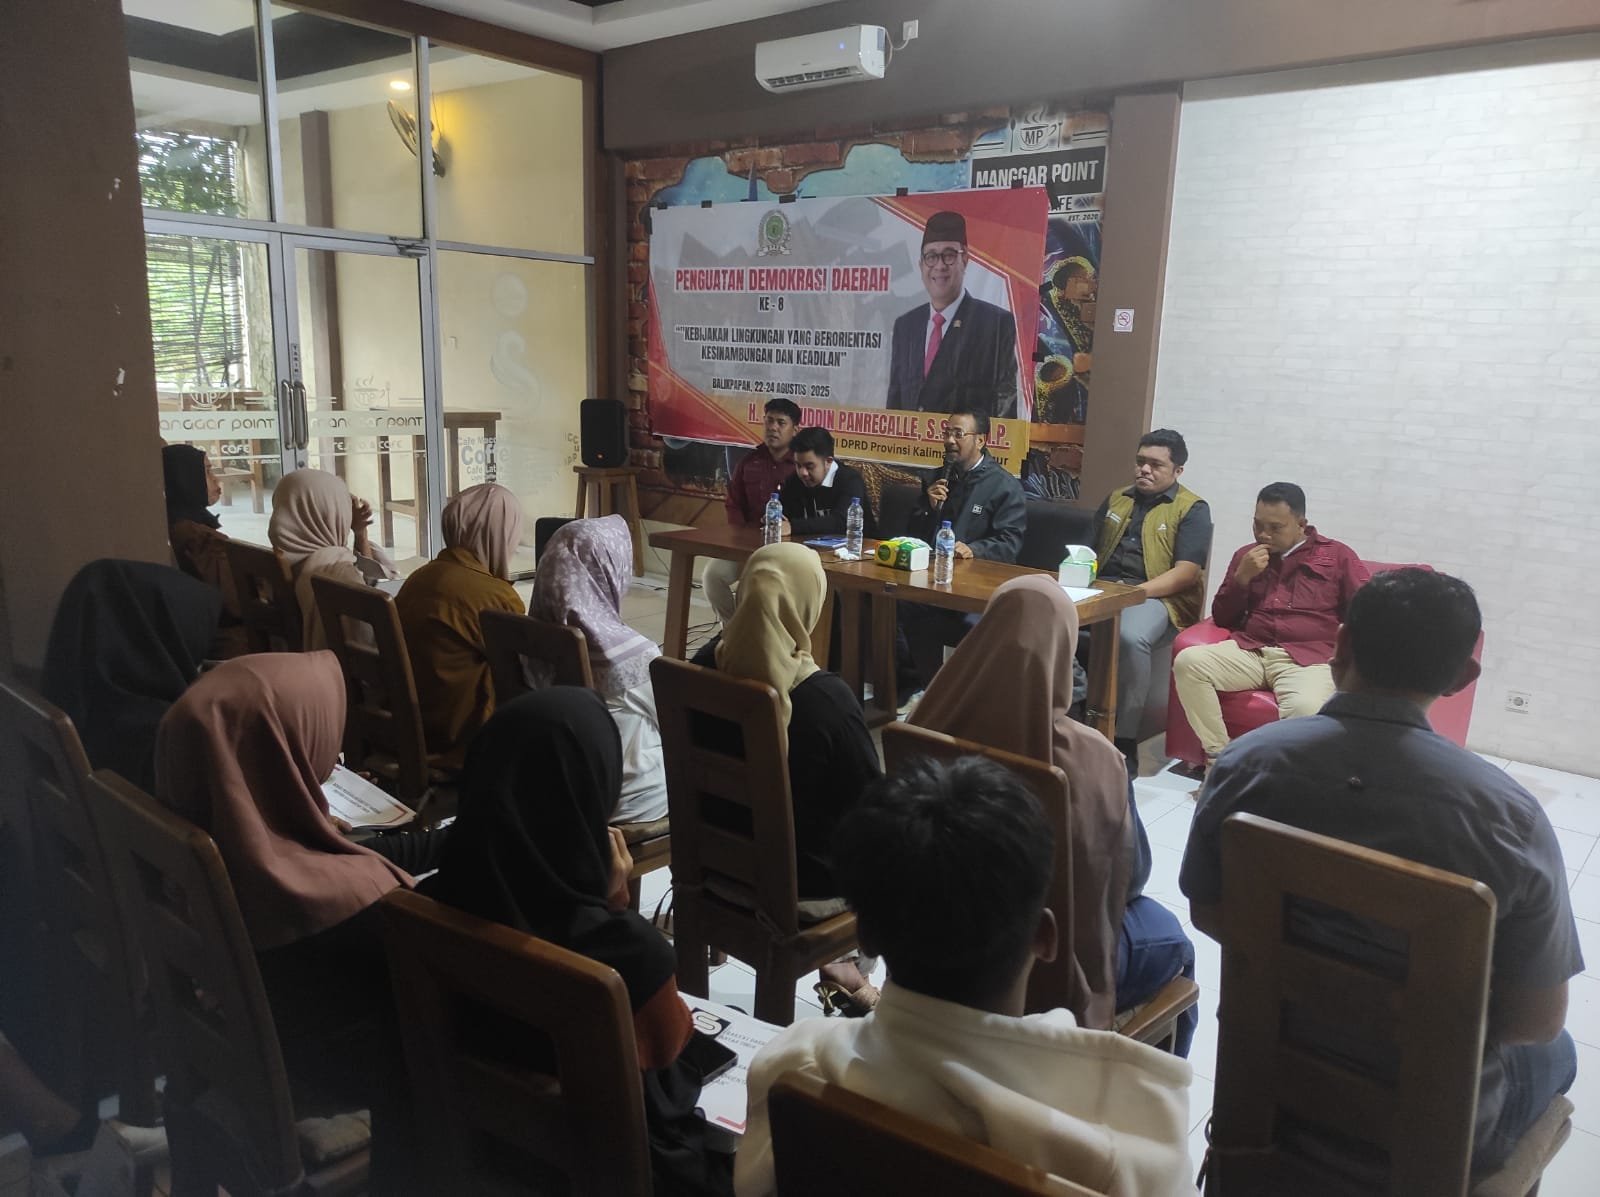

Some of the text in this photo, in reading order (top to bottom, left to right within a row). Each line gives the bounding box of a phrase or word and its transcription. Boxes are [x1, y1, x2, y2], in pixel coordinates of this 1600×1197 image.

[1025, 130, 1043, 144] MP
[976, 160, 1099, 187] MANGGAR POINT
[676, 267, 890, 292] PENGUATAN DEMOKRASI DAERAH
[759, 296, 770, 311] KE
[778, 296, 784, 311] 8
[731, 328, 785, 345] LINGKUNGAN
[787, 330, 811, 346] YANG
[814, 331, 882, 349] BERORIENTASI
[701, 345, 773, 363] KESINAMBUNGAN
[775, 348, 794, 365] DAN
[754, 380, 775, 393] 22-24
[776, 381, 807, 396] AGUSTUS
[810, 384, 830, 397] 2025
[748, 403, 759, 422] H.
[838, 409, 922, 441] PANRECALLE,
[841, 439, 868, 451] DPRD
[870, 441, 911, 456] Provinsi
